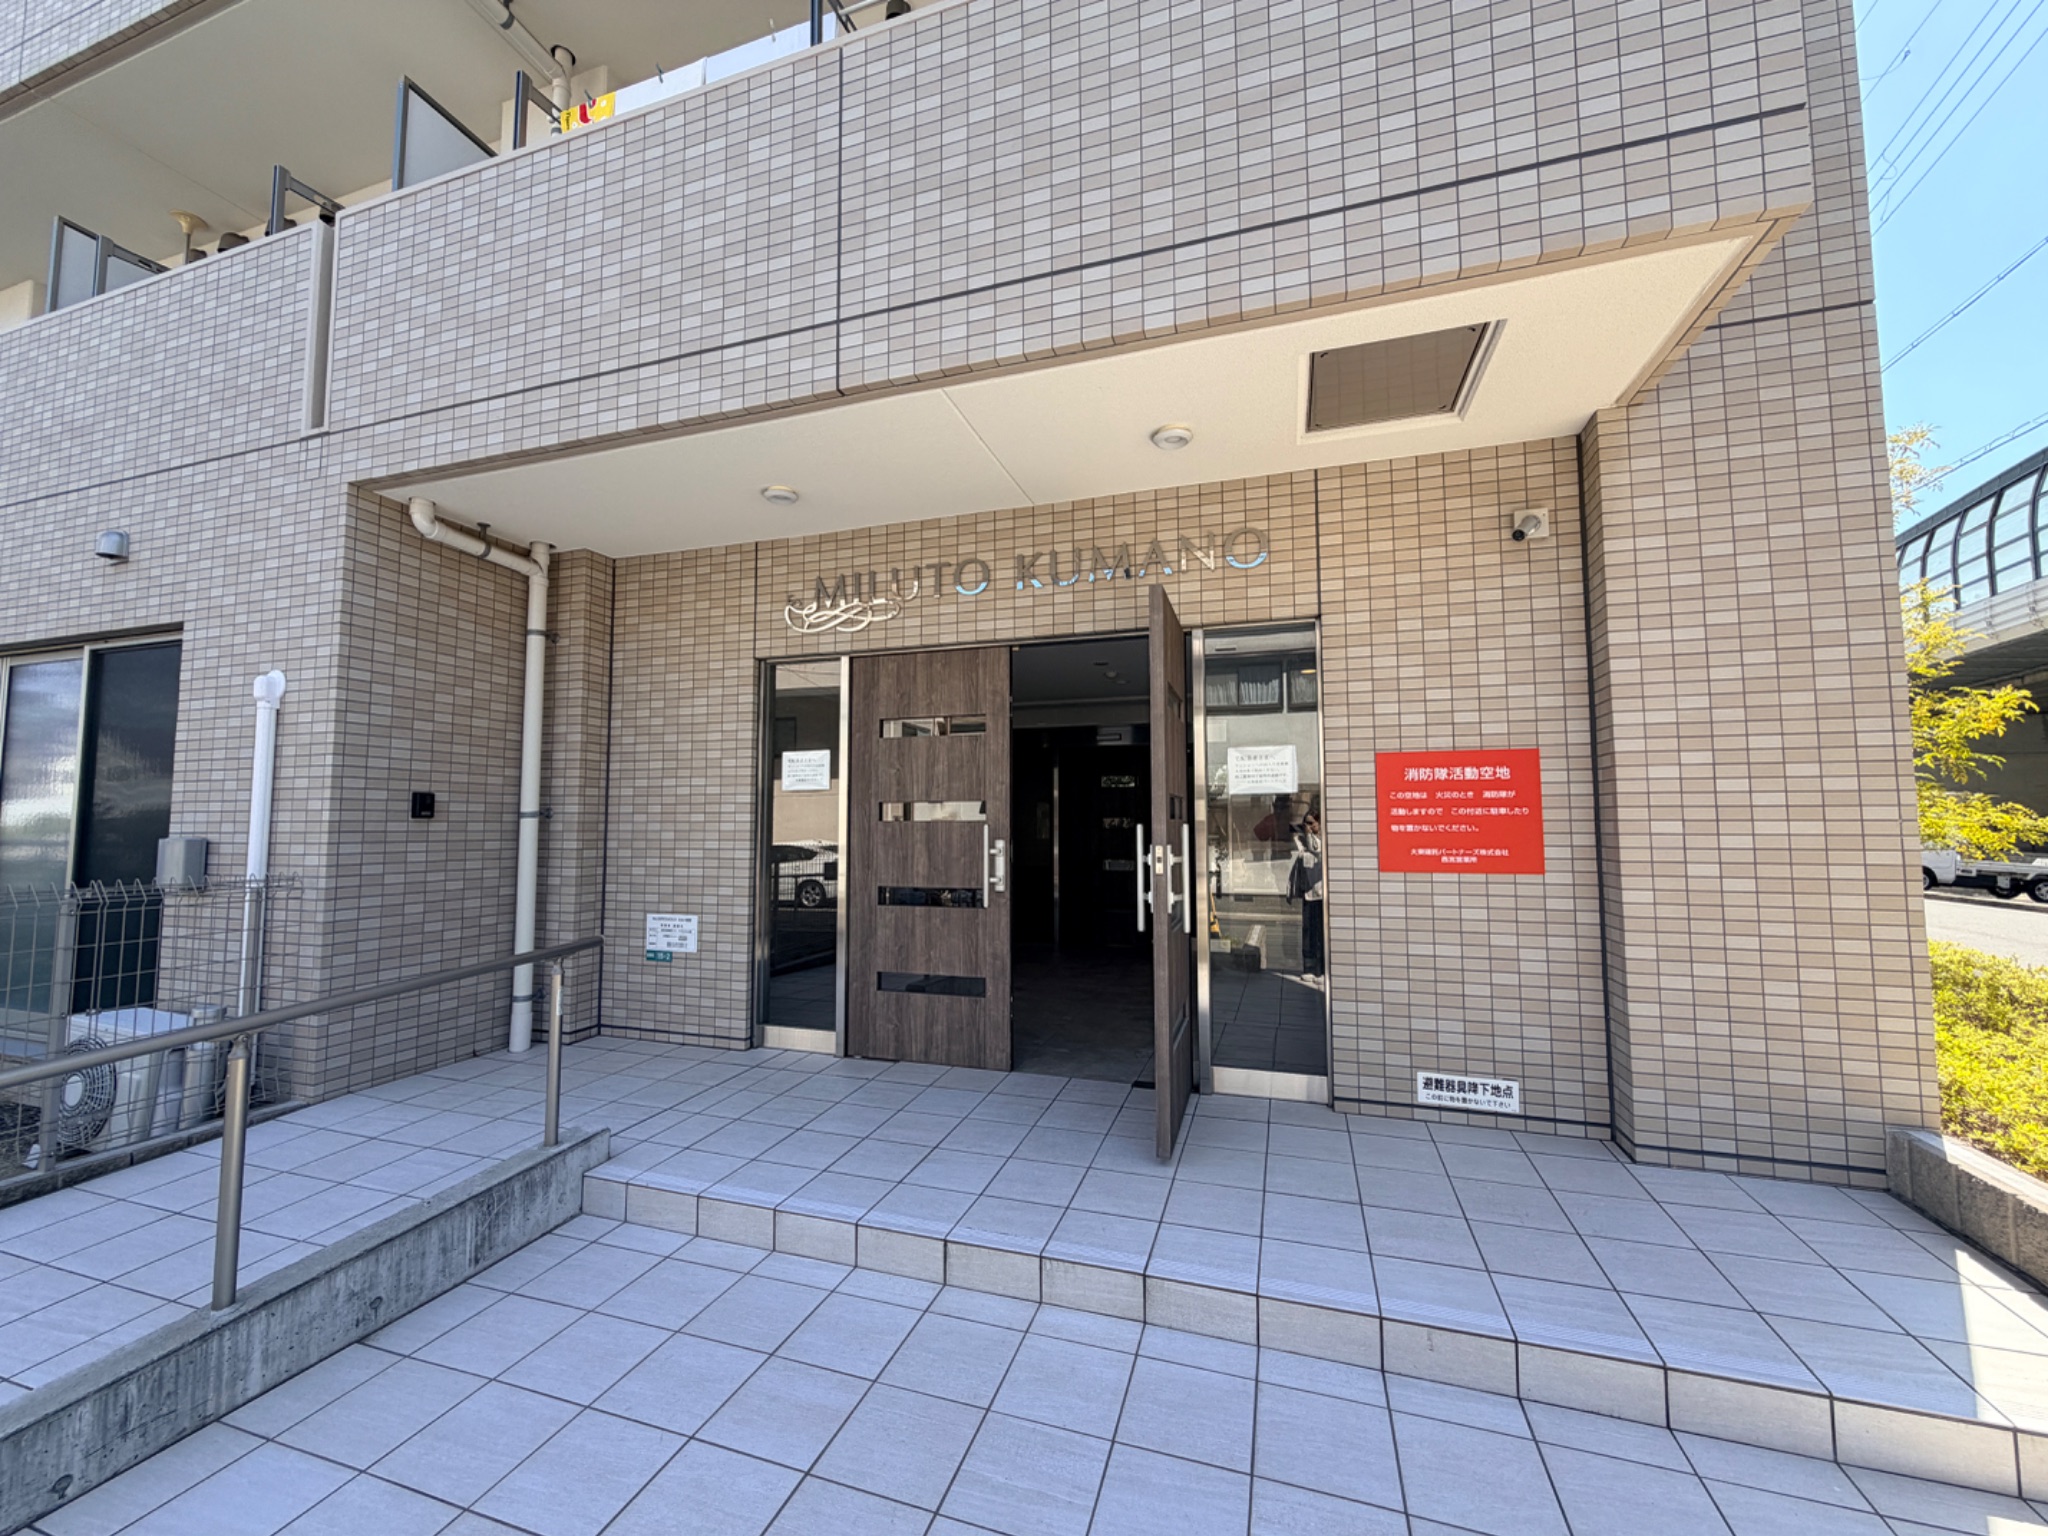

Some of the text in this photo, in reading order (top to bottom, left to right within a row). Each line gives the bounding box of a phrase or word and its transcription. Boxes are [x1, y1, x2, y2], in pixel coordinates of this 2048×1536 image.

[813, 527, 1269, 608] MILUTO KUMANO
[1404, 766, 1511, 782] 消防隊活動空地
[1389, 789, 1516, 800] この空地は 火災のとき 消防隊が
[1390, 807, 1530, 817] 活動しますので この付近に駐車したり
[1422, 1076, 1514, 1099] 避難器具降下地点
